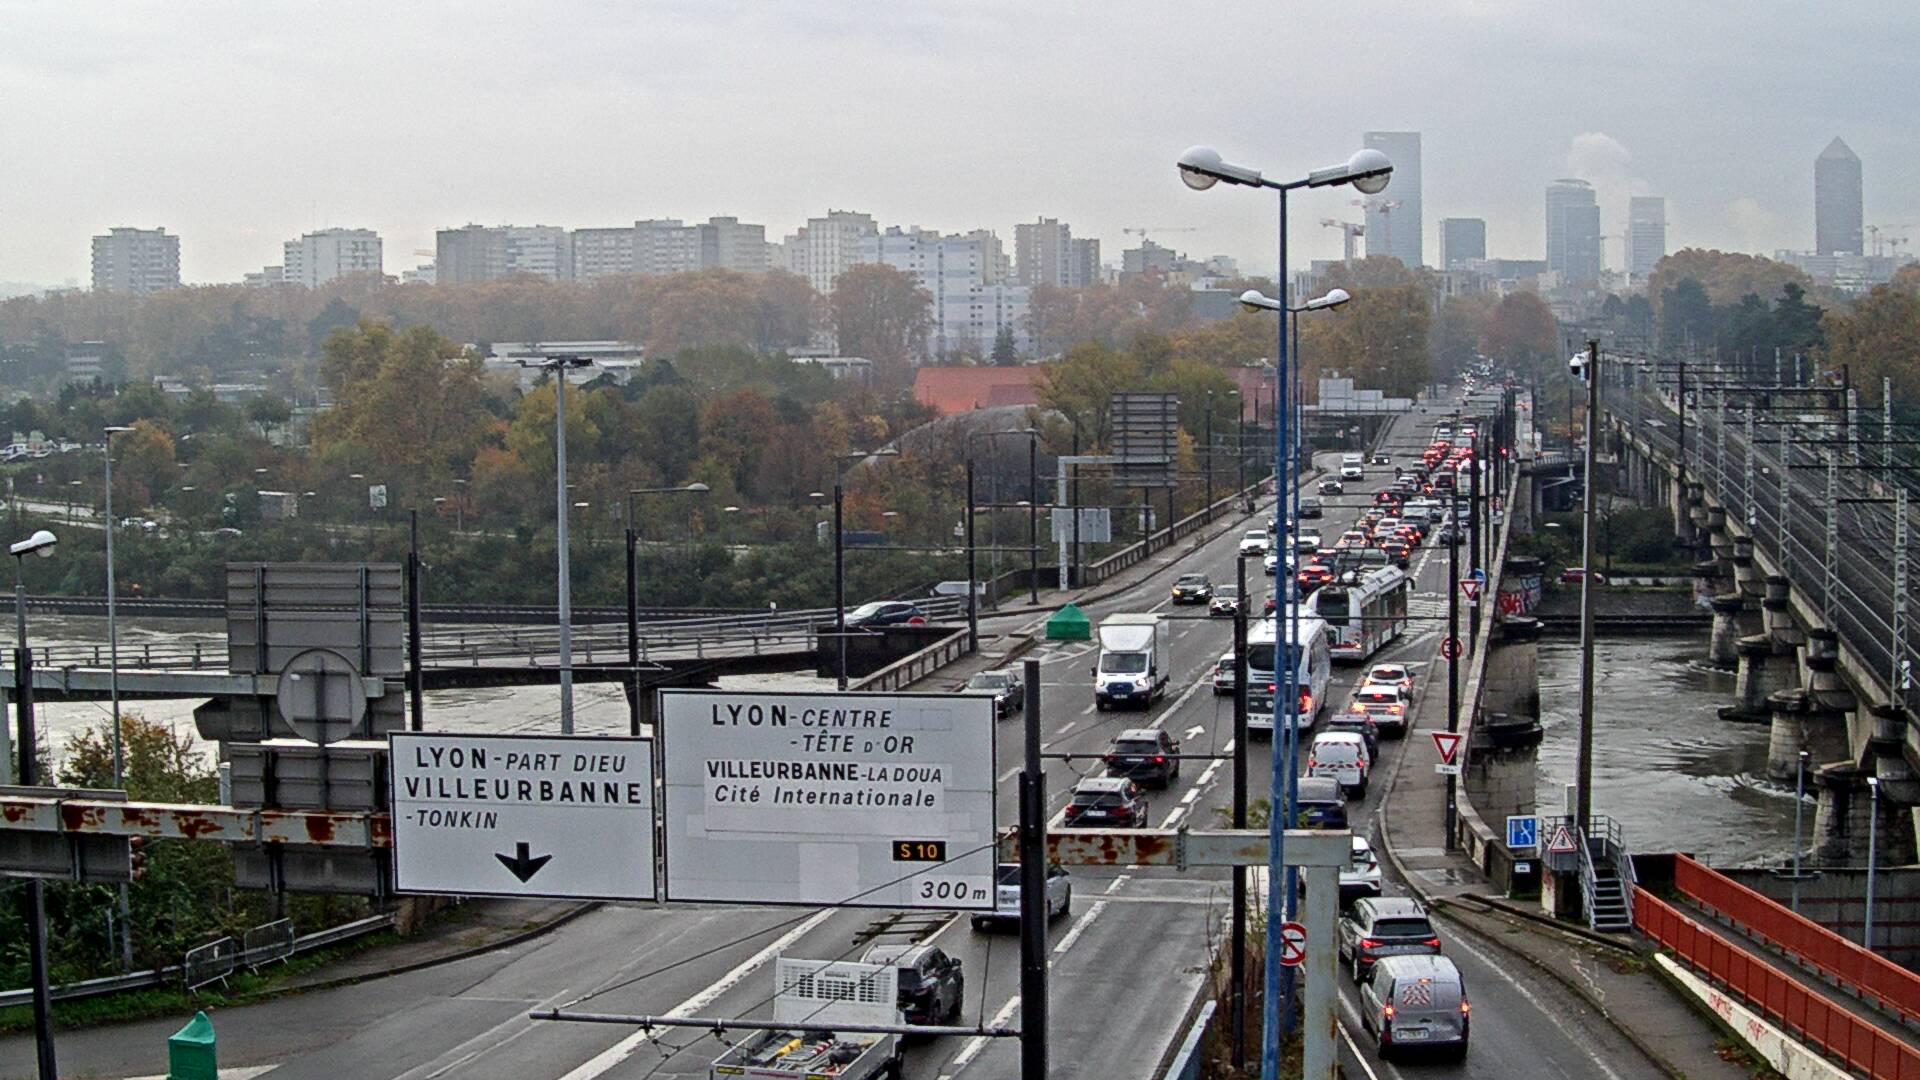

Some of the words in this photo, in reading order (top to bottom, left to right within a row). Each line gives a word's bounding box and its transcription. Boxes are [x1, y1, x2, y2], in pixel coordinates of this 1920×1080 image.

[790, 729, 855, 753] -TÊTE
[573, 754, 626, 773] DIEU
[893, 768, 943, 783] DOUA
[405, 776, 641, 804] VILLEURBANNE
[715, 785, 760, 803] Cité
[773, 786, 936, 807] Internationale
[406, 809, 498, 830] -TONKIN
[921, 881, 968, 899] 300
[972, 889, 987, 900] m
